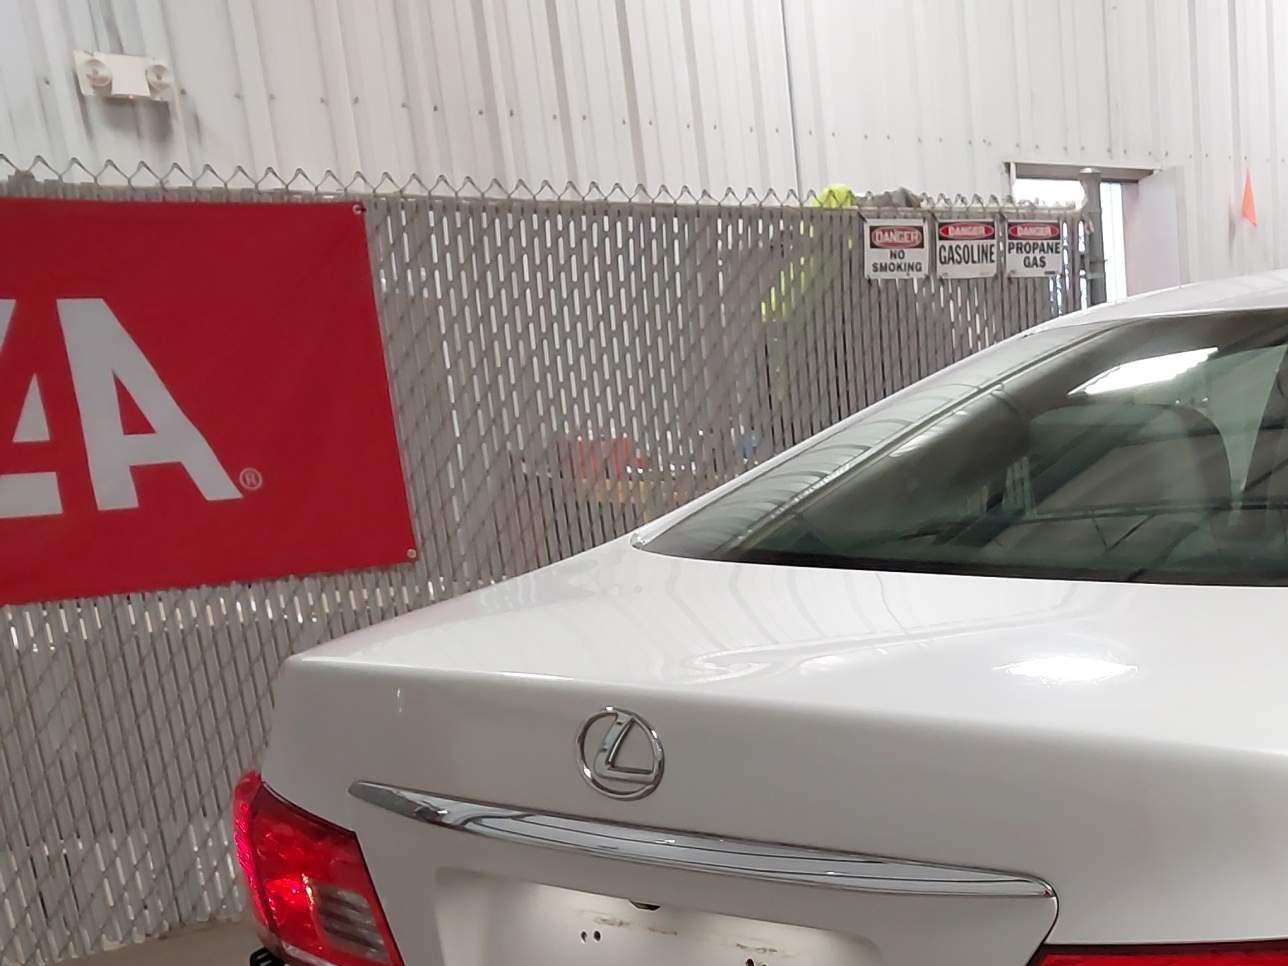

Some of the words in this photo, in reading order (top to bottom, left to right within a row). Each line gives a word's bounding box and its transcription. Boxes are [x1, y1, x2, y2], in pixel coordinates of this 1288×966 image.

[874, 230, 919, 242] DANGER
[1007, 241, 1061, 254] PROPANE
[889, 249, 906, 260] NO
[939, 243, 995, 265] GASOLINE
[871, 261, 922, 272] SMOKING
[1023, 255, 1047, 268] GAS
